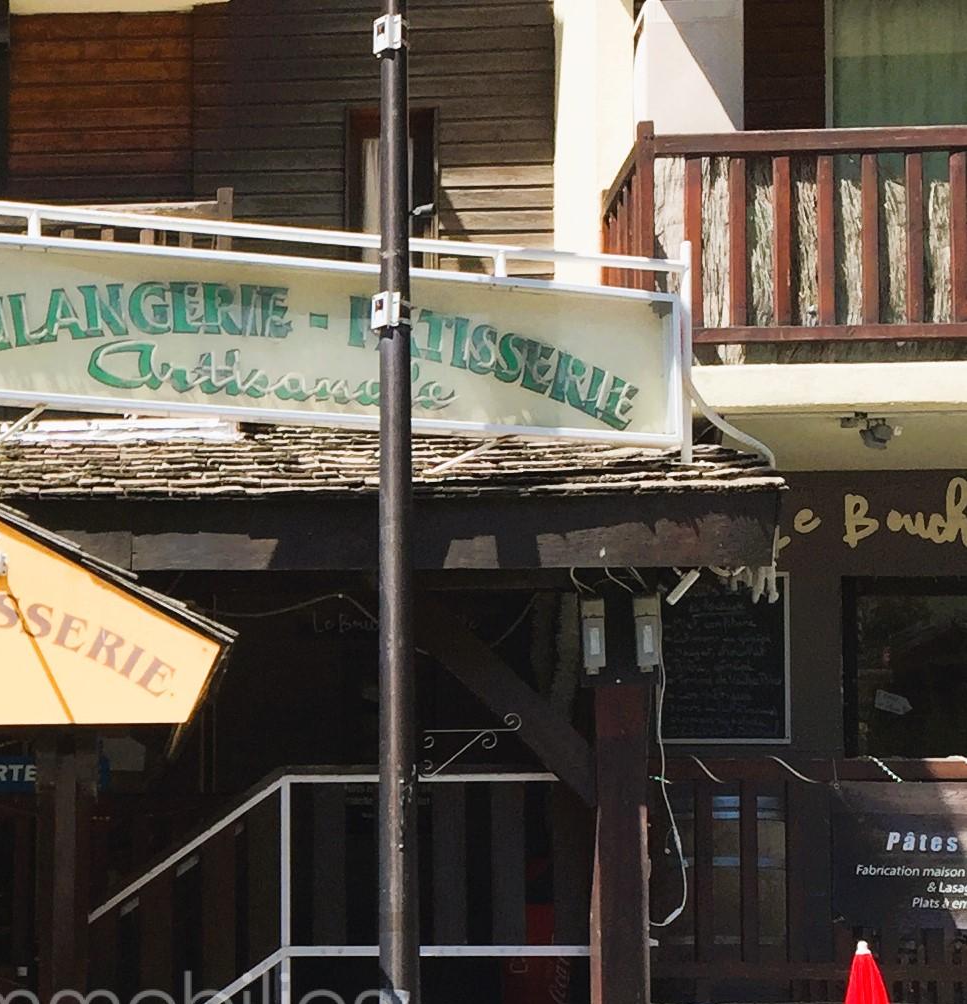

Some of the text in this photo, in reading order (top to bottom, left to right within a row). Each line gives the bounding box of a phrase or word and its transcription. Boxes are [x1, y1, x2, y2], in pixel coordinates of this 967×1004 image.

[348, 295, 640, 431] PTISSERIE
[87, 339, 460, 411] Artisanae
[885, 831, 958, 853] Pâtes
[855, 863, 966, 879] Fabrication maison
[926, 881, 937, 893] &
[912, 896, 940, 909] Plats
